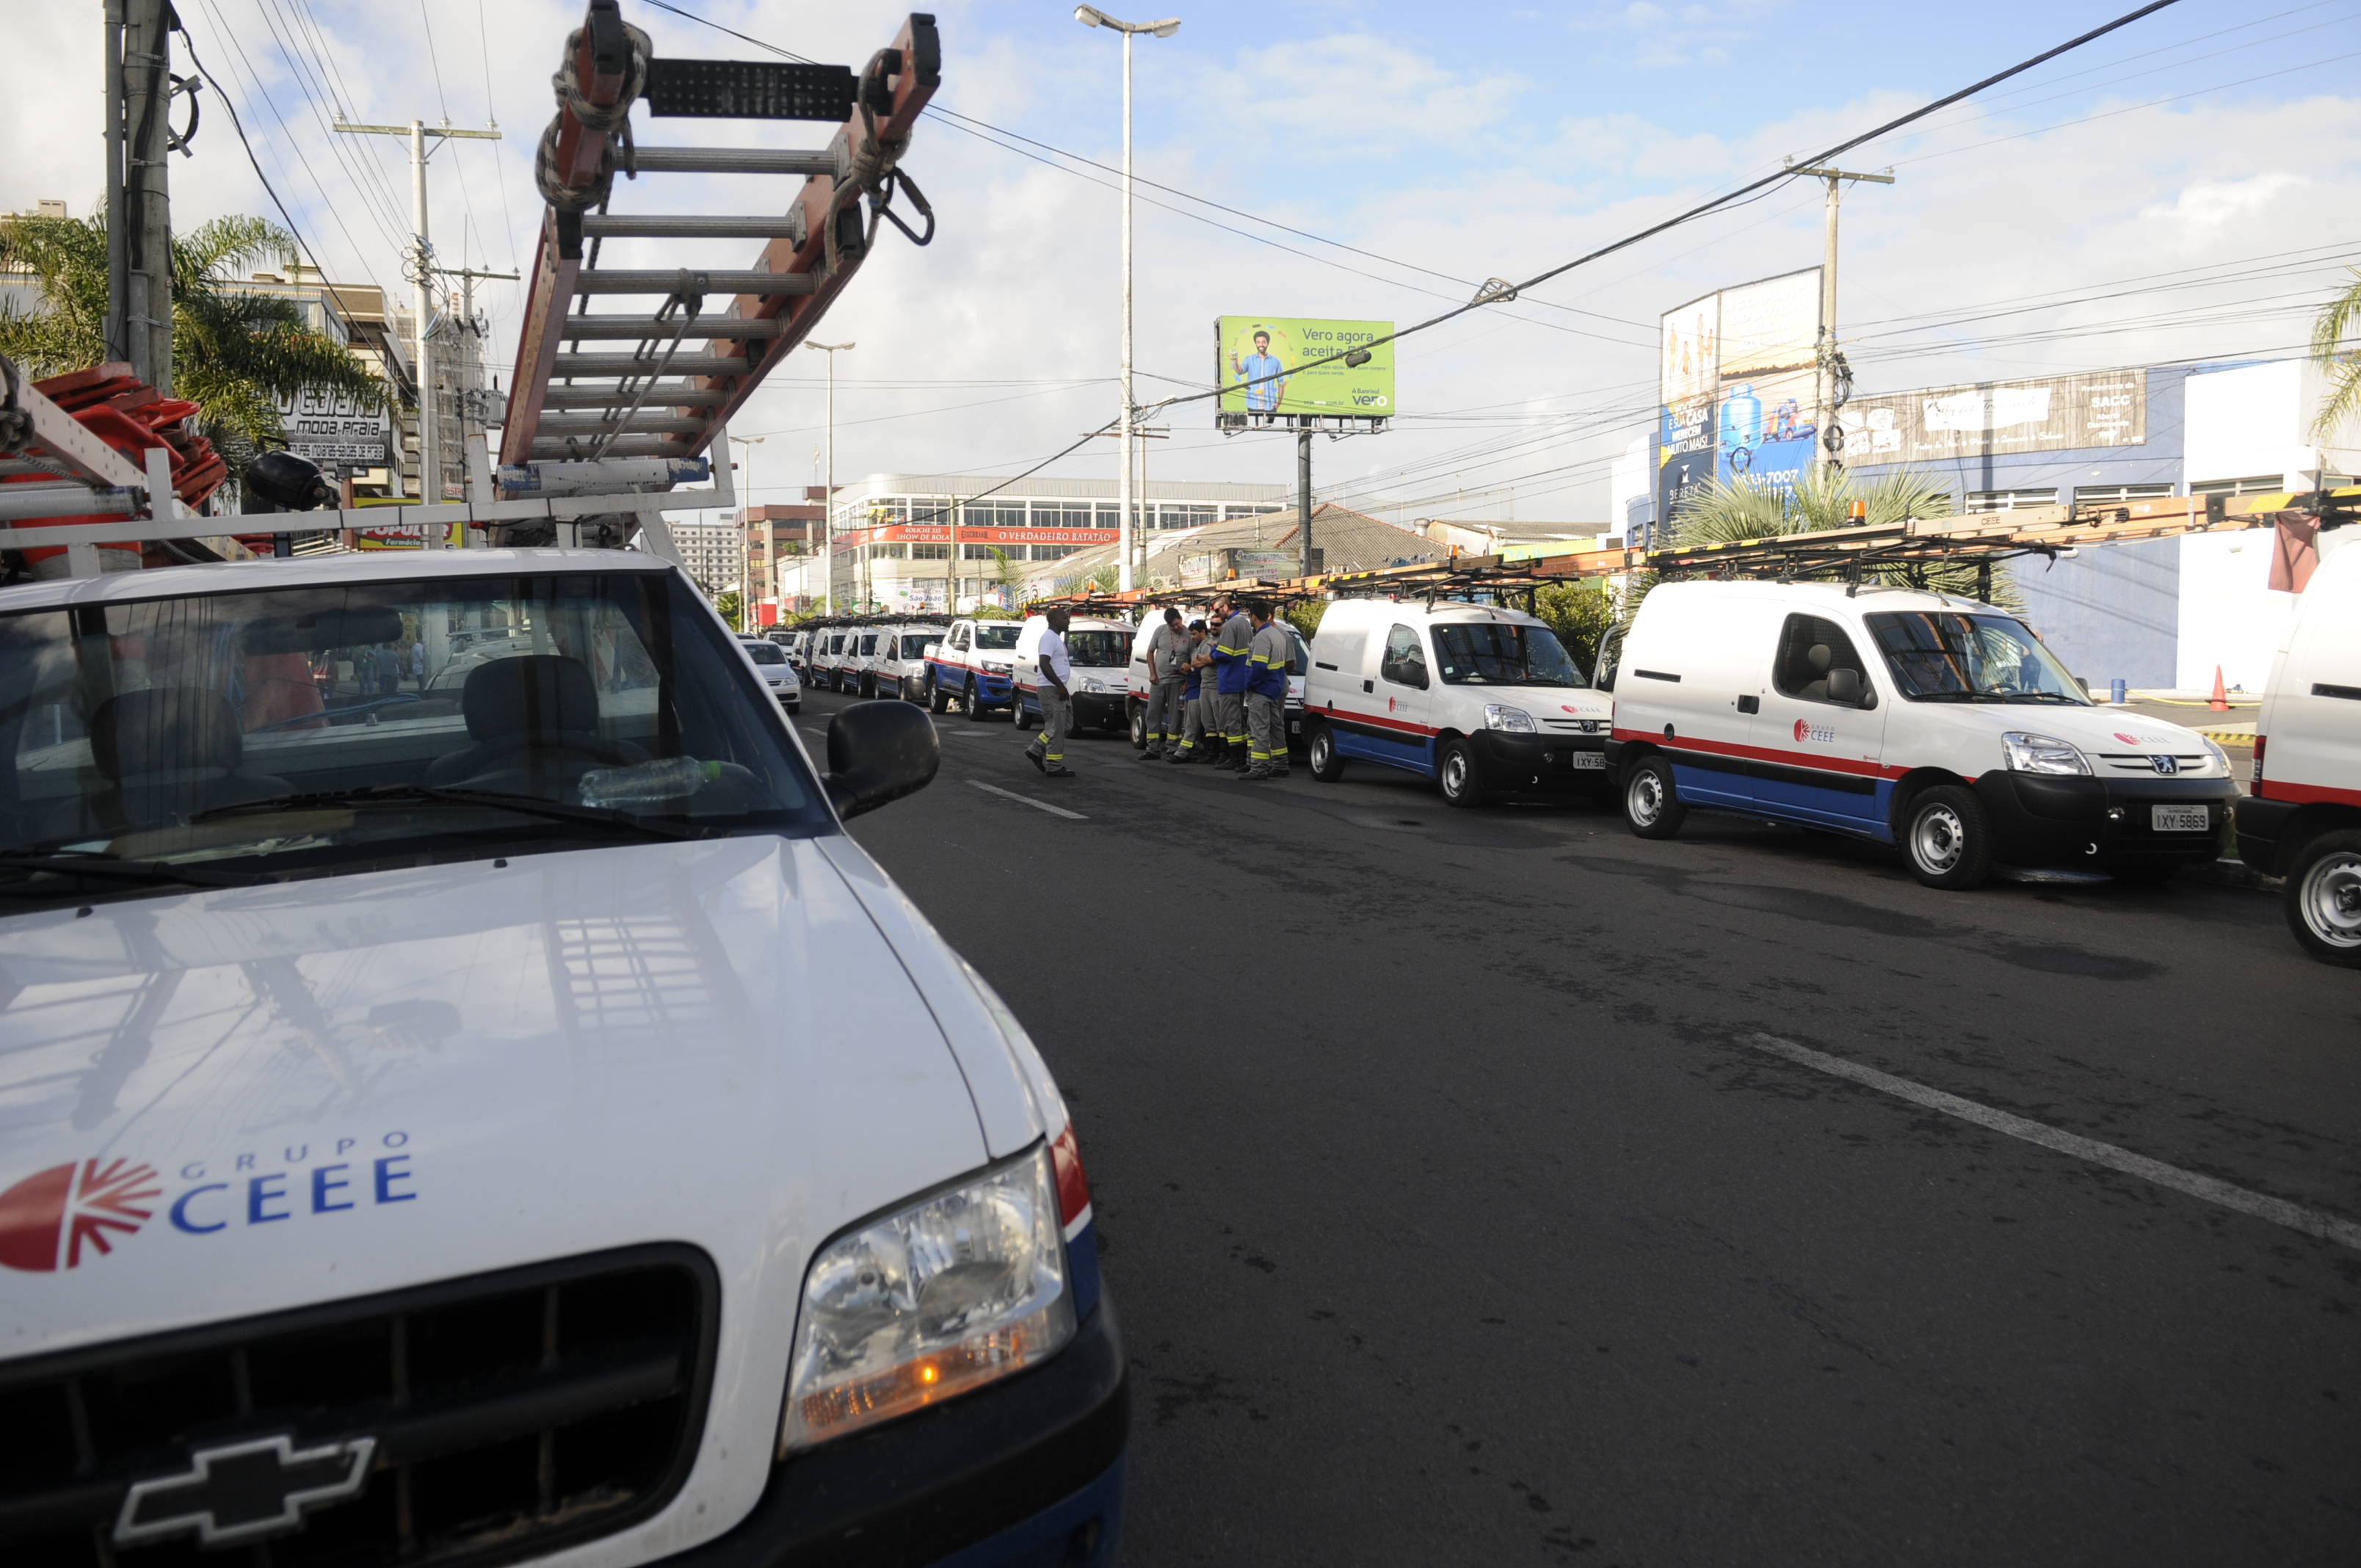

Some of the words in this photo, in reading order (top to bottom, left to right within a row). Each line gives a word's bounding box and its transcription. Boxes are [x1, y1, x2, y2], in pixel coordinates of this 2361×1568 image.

[1741, 321, 1774, 338] AZUL
[1777, 316, 1796, 331] NA
[1302, 328, 1332, 341] Vero
[1337, 332, 1374, 344] agora
[1766, 330, 1801, 346] CASA
[1302, 345, 1343, 357] aceita
[2081, 383, 2124, 392] Restaurante
[1352, 396, 1388, 407] vero
[2092, 394, 2130, 407] SACC
[1669, 418, 1673, 430] E
[1673, 415, 1686, 429] SUA
[1686, 407, 1709, 427] CASA
[2087, 421, 2130, 429] Diariamente
[1672, 424, 1702, 440] MERECEM
[1667, 440, 1689, 455] MUITO
[1689, 435, 1708, 451] MAIS!
[1981, 516, 2001, 526] CEEE
[362, 524, 449, 537] POPULR
[999, 531, 1007, 540] O
[1009, 531, 1069, 541] VERDADEIRO
[1072, 531, 1111, 542] BATATÃO
[1811, 730, 1835, 743] CEEE
[181, 1131, 409, 1180] GRUPO
[169, 1154, 417, 1235] CEEE
